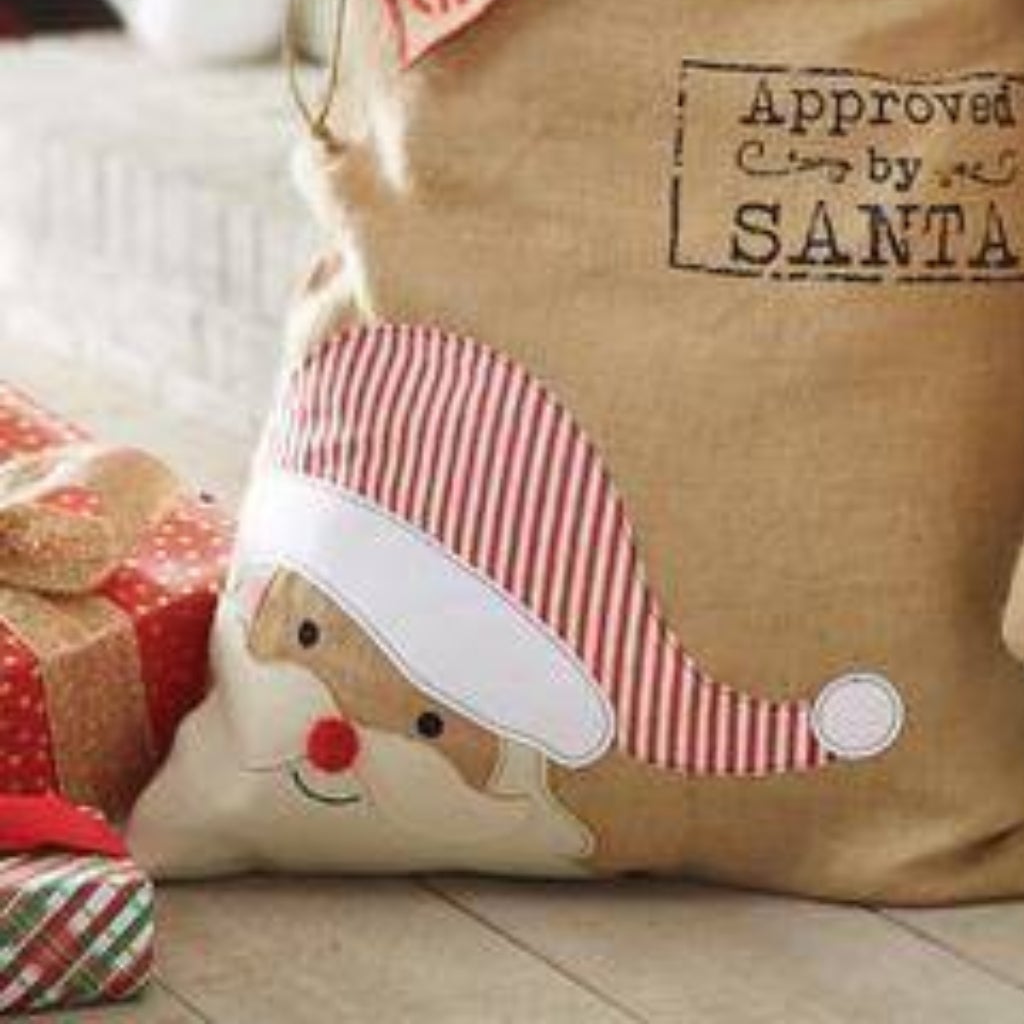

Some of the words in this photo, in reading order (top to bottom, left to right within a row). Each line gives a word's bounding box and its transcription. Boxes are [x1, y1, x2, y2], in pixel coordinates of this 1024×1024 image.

[739, 77, 1017, 138] Approved
[866, 146, 922, 191] by
[731, 200, 1020, 269] SANTA
